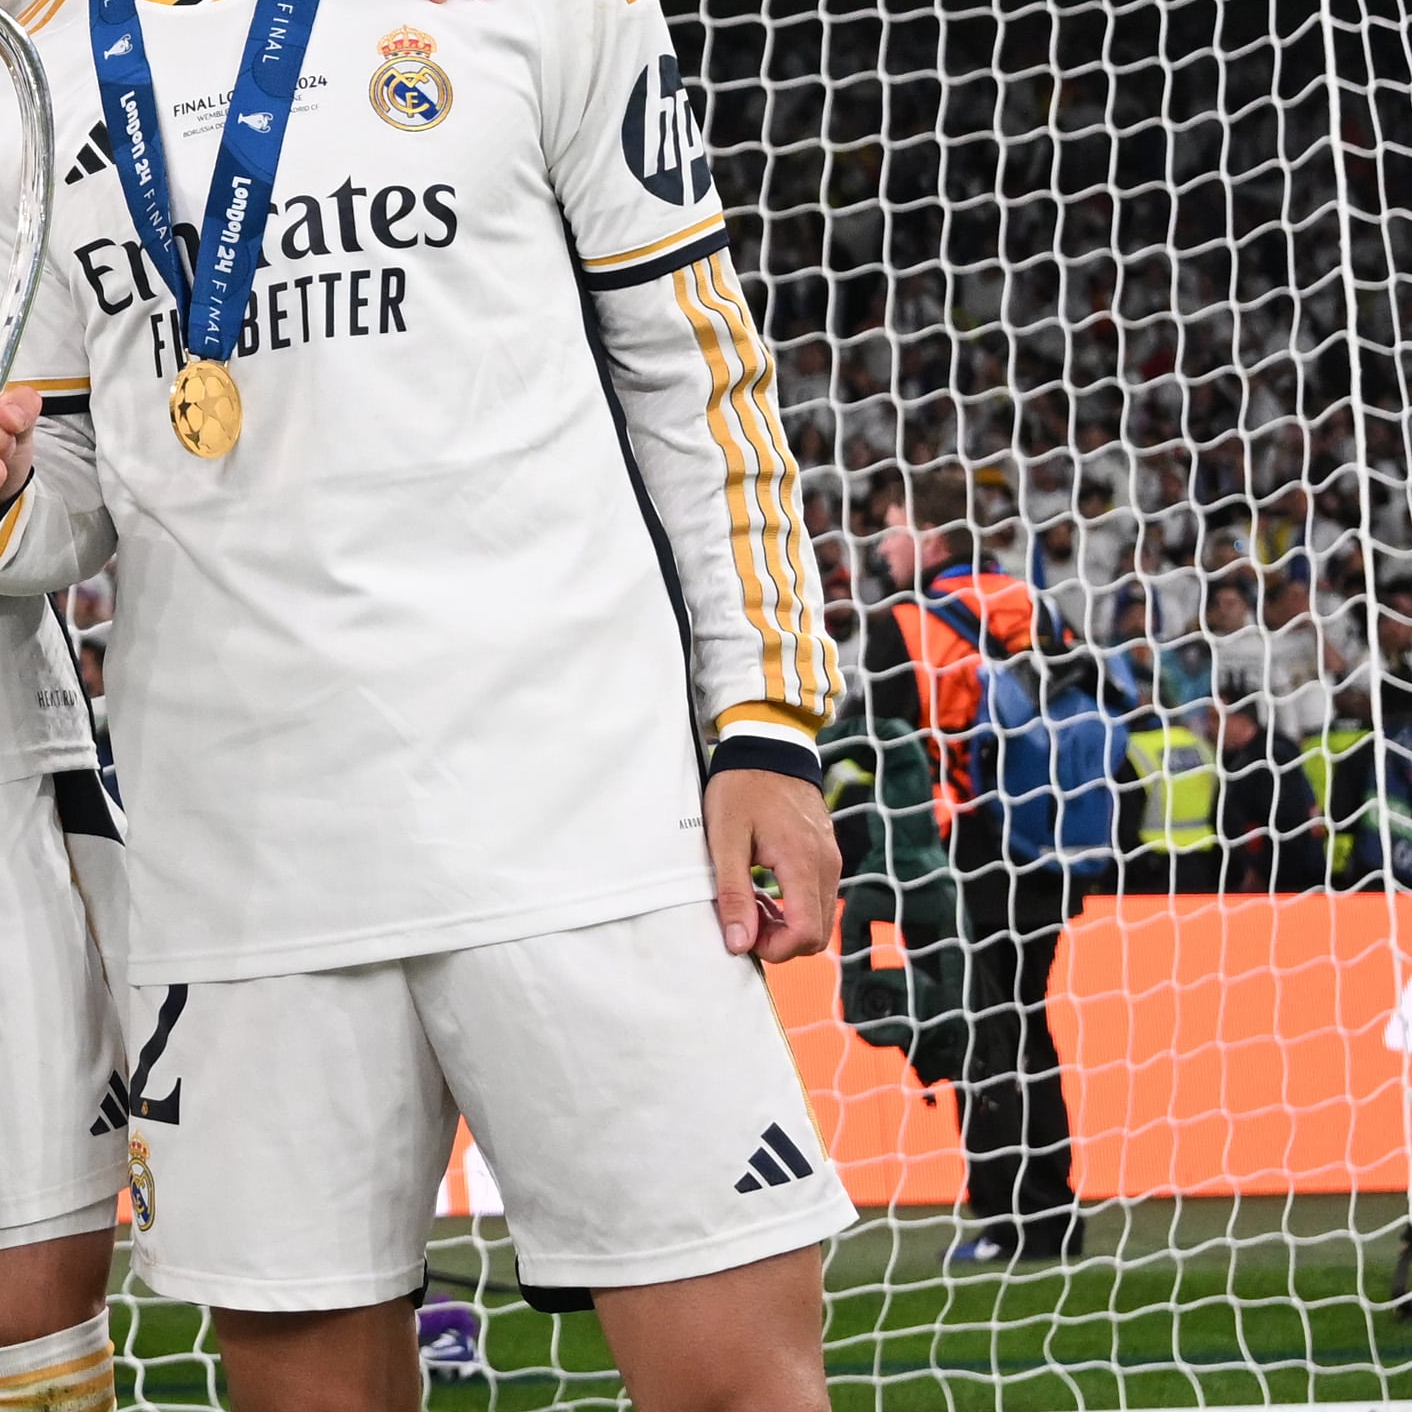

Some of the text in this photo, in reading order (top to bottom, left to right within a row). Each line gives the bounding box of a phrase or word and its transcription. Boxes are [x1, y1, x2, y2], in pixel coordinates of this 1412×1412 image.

[262, 2, 294, 64] FINAL
[173, 96, 216, 118] FINAL
[295, 75, 329, 91] 024
[196, 108, 229, 123] WEMBL
[182, 125, 215, 139] BORUSSIA
[644, 56, 705, 205] hp
[134, 159, 153, 187] 24
[74, 175, 458, 316] Emates
[143, 188, 173, 253] FINAL
[214, 244, 236, 274] 24
[150, 267, 407, 379] FL BETTER
[204, 279, 227, 346] FINAL
